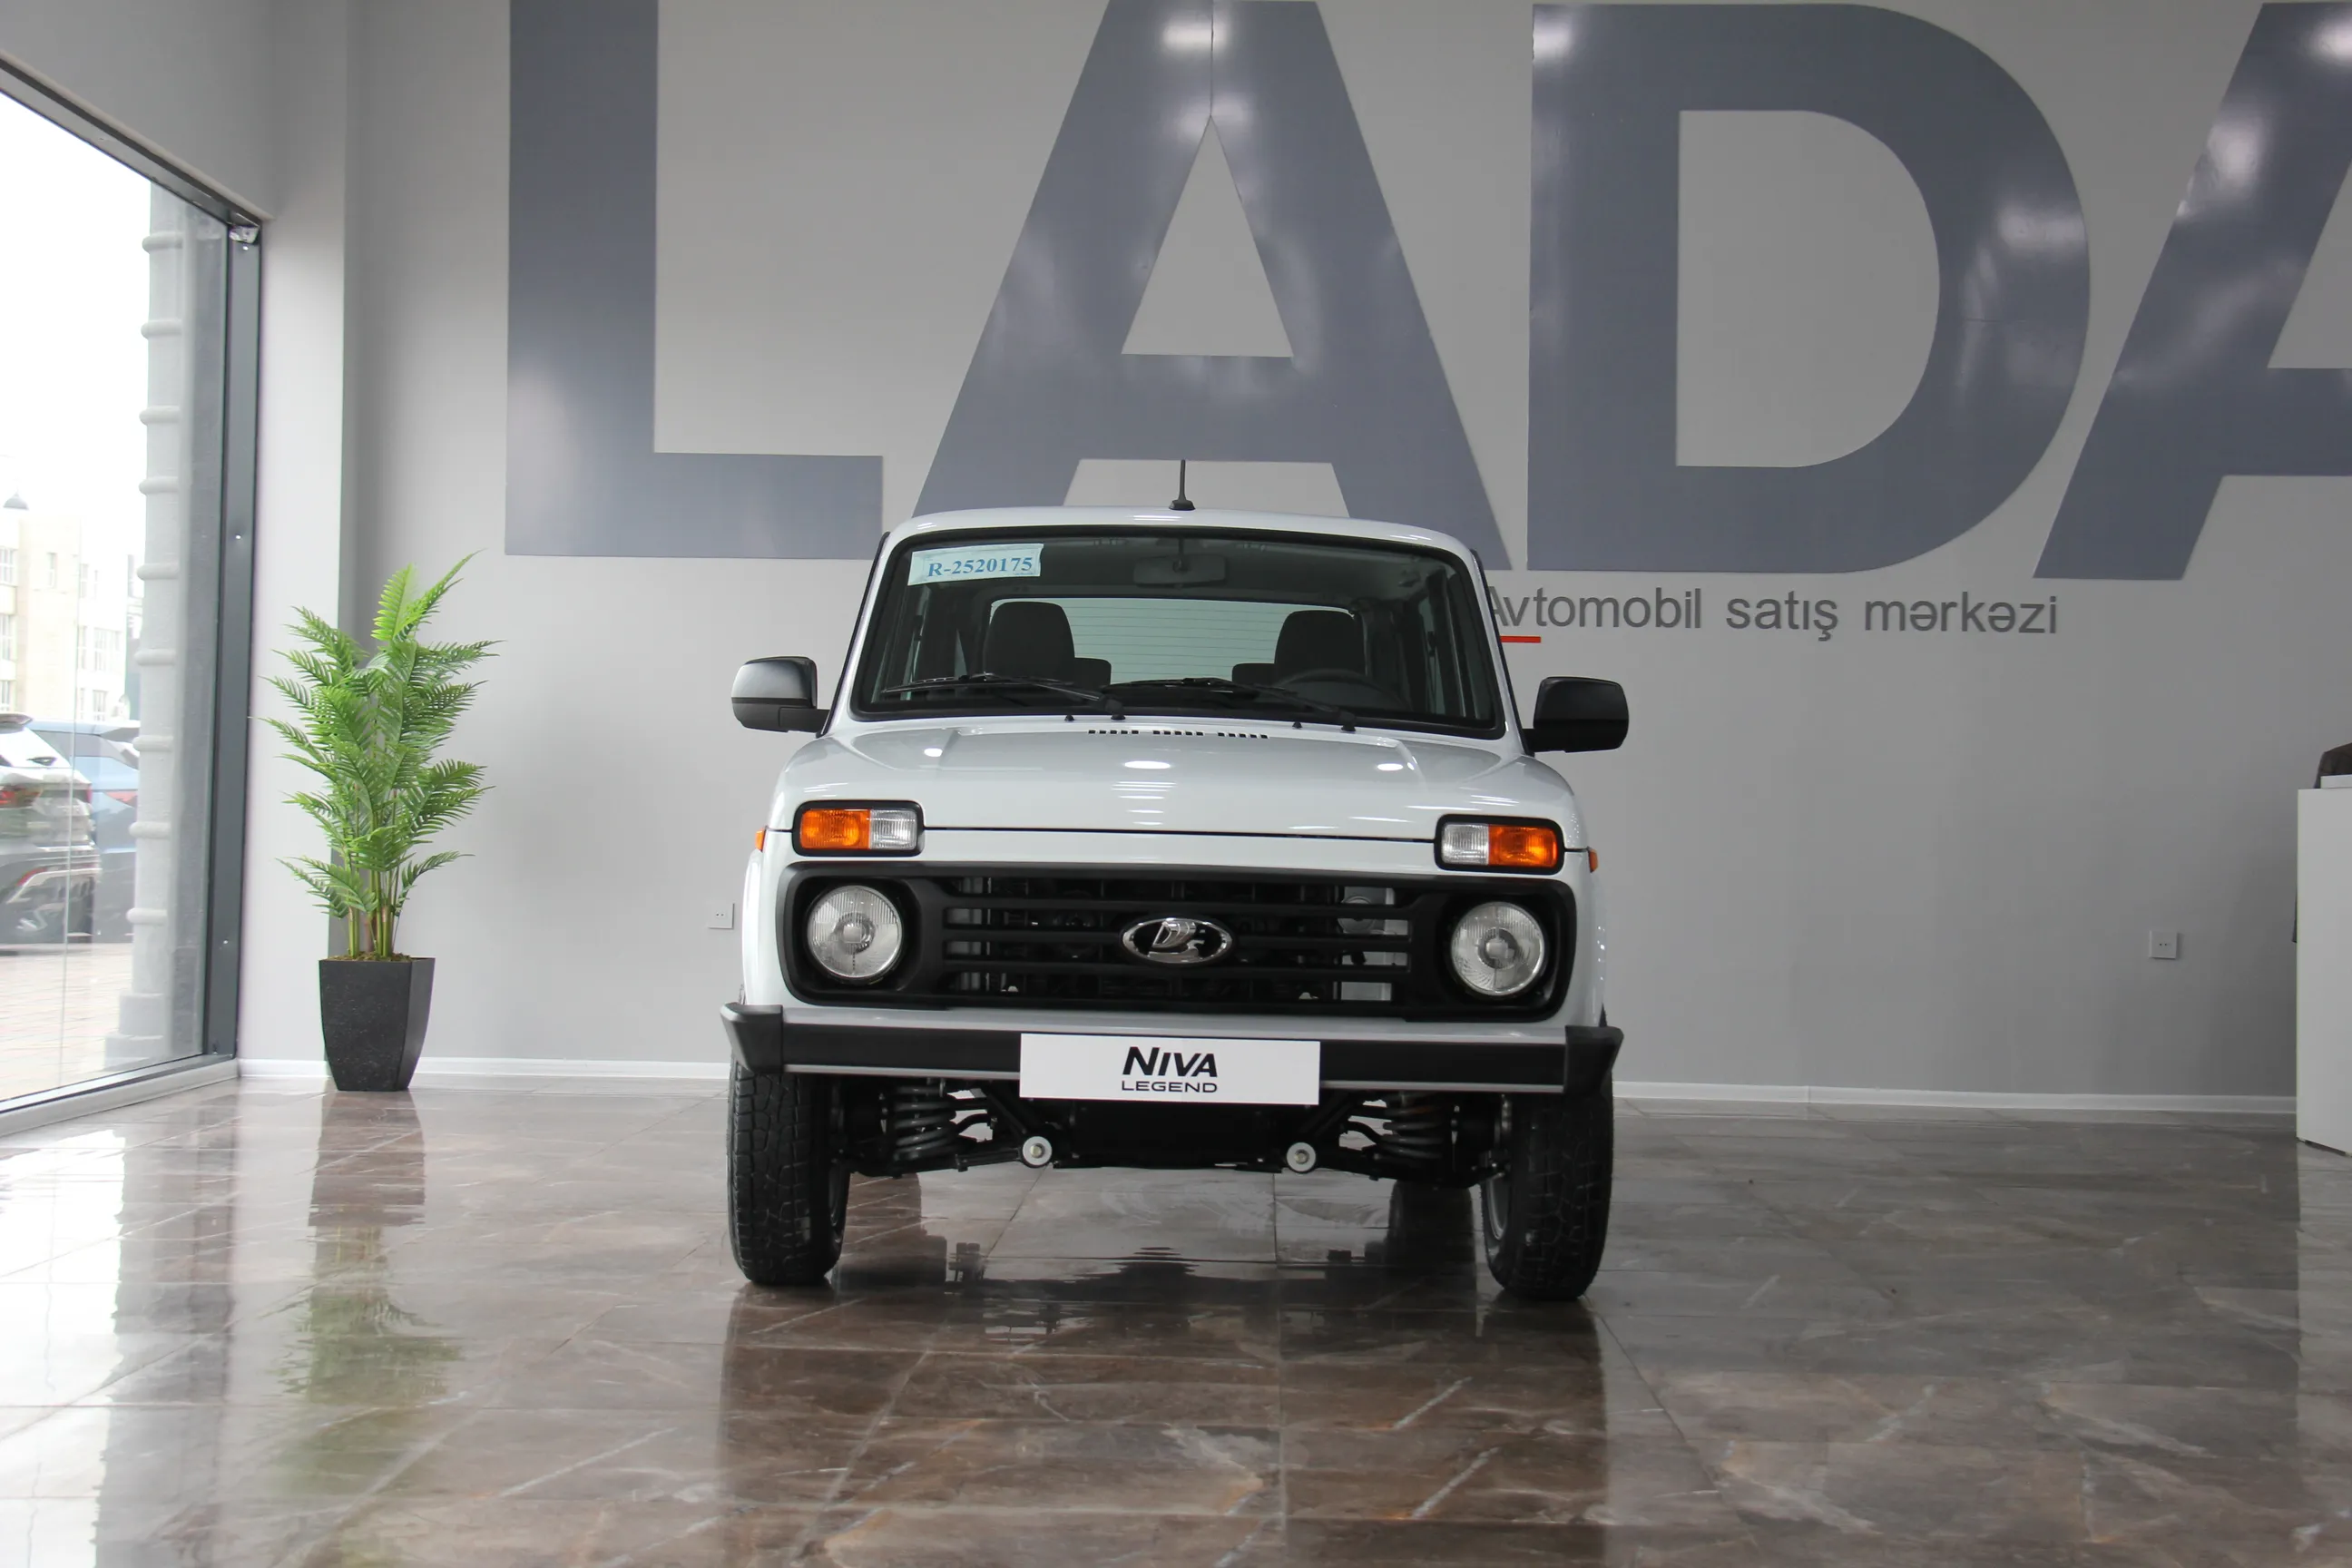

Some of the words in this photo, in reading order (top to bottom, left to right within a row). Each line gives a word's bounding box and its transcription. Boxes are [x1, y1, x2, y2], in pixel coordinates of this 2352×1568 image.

[927, 557, 1033, 577] R-2520175
[1726, 591, 1838, 641] satış
[1865, 593, 2057, 633] mərkəzi
[1122, 1046, 1218, 1077] NIVA
[1122, 1080, 1218, 1093] LEGEND
